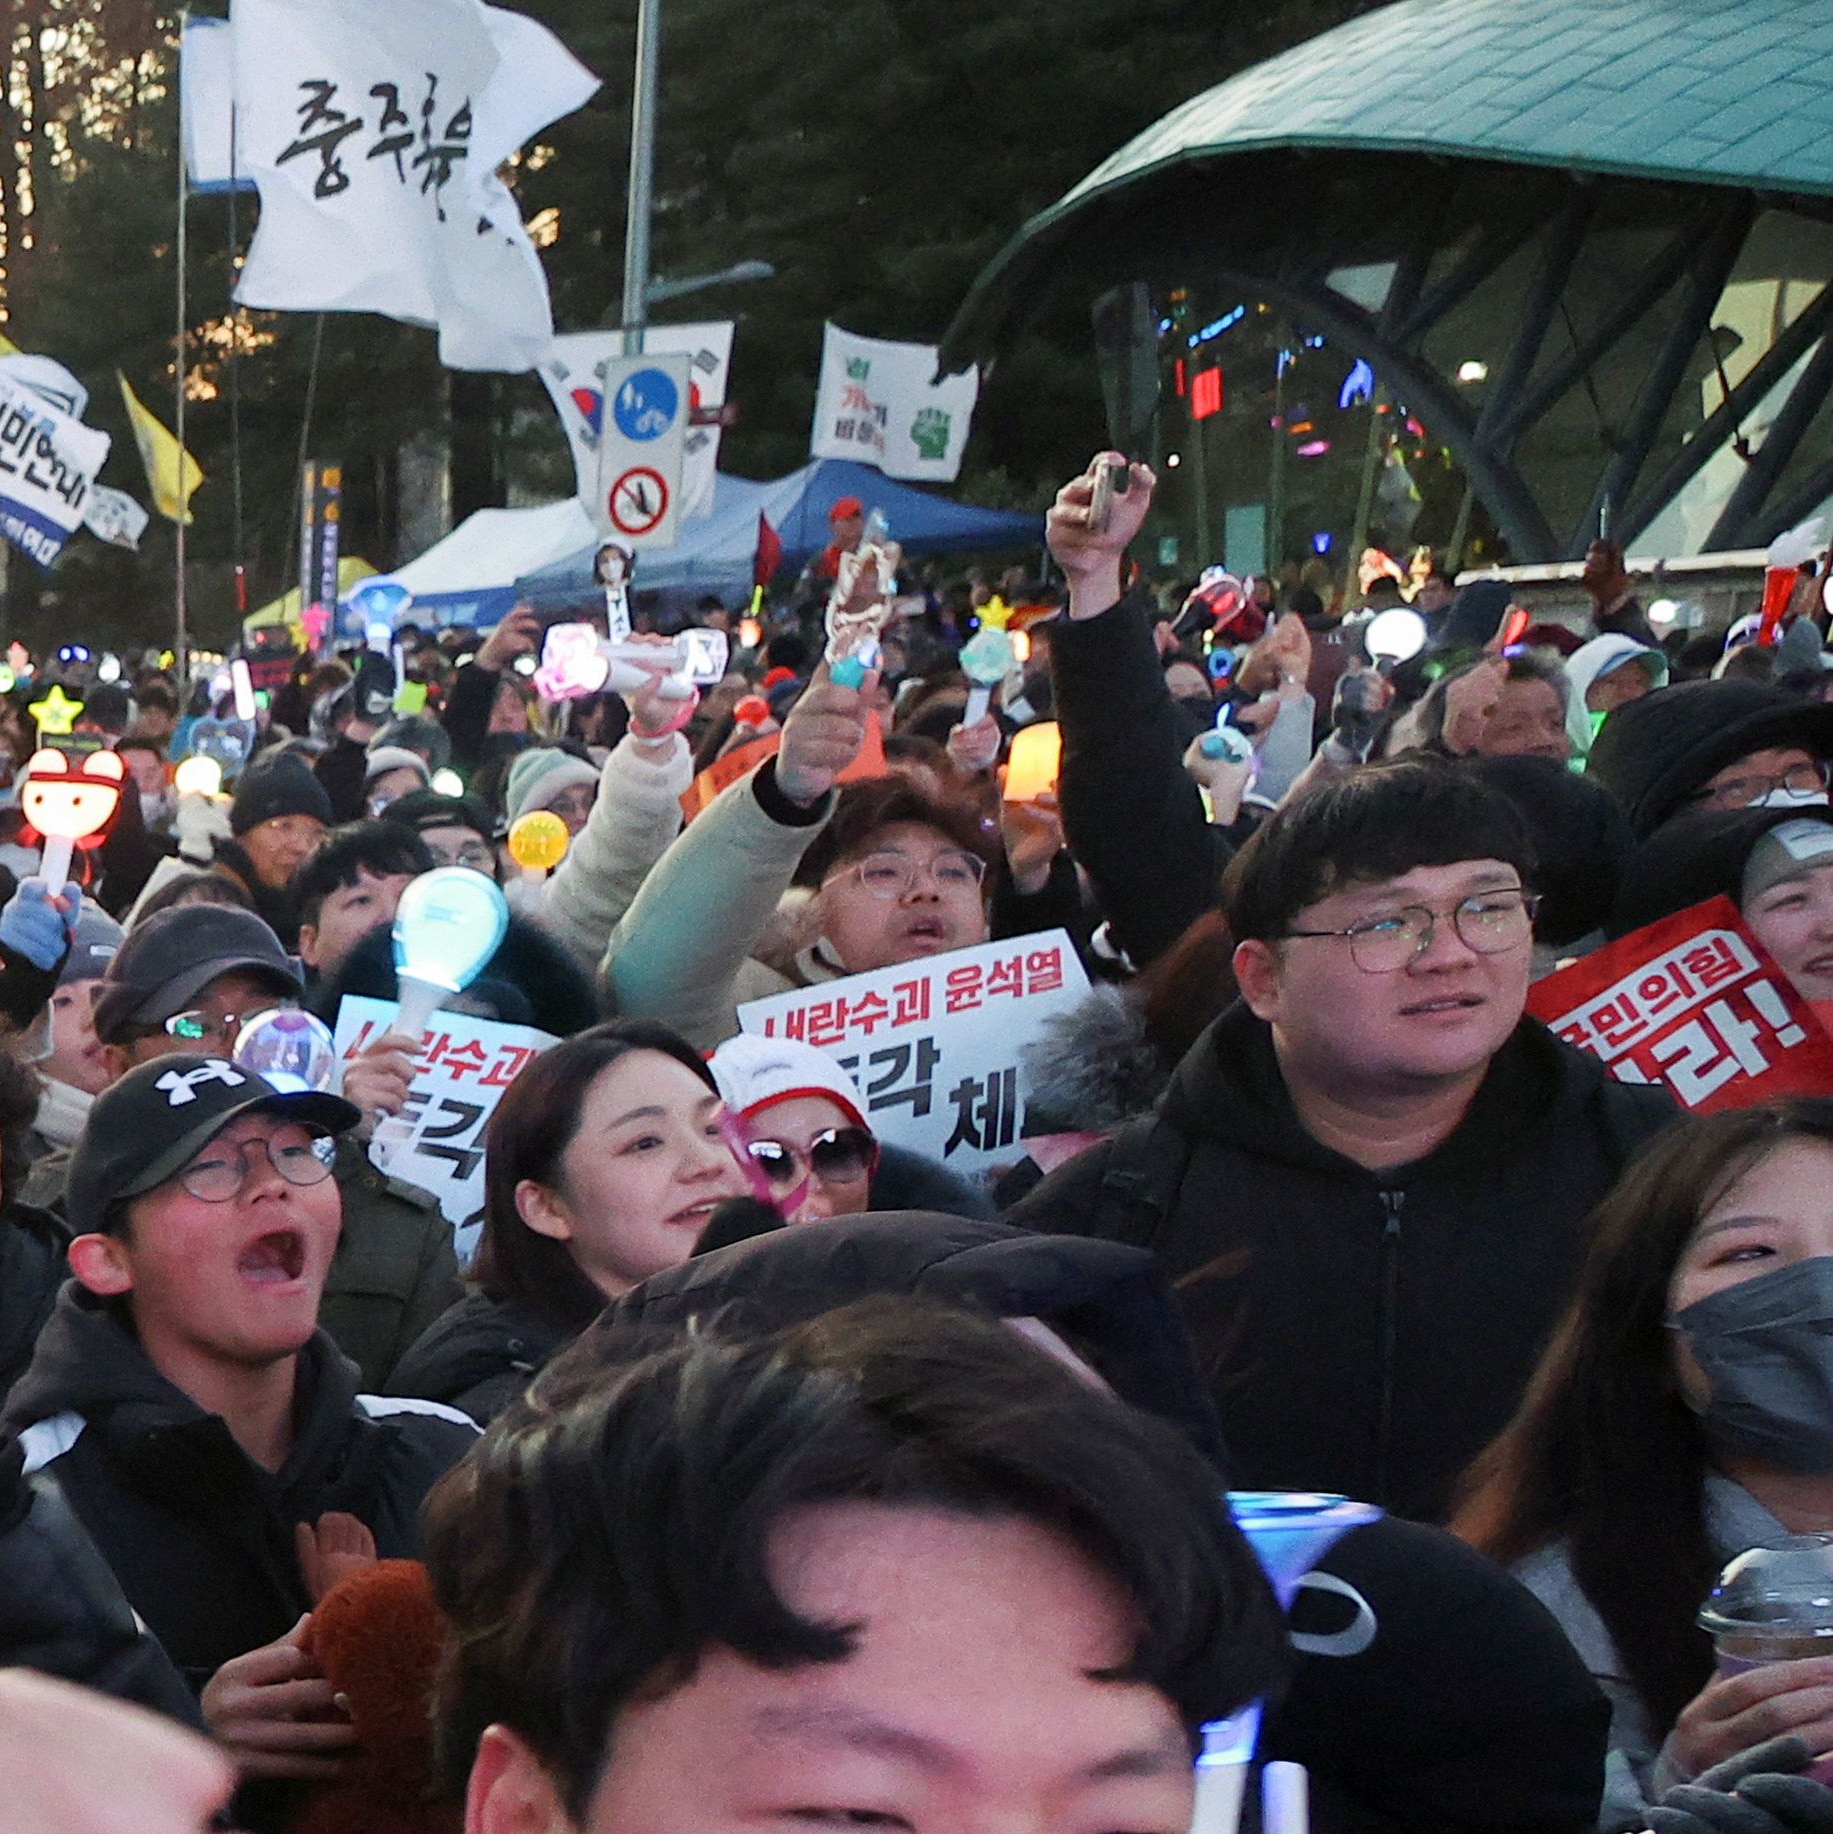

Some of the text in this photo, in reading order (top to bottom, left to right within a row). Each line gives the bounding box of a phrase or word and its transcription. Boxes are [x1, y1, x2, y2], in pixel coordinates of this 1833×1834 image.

[944, 947, 1063, 1015] 윤석열
[1612, 978, 1807, 1108] 라!
[944, 1067, 1028, 1159] 체
